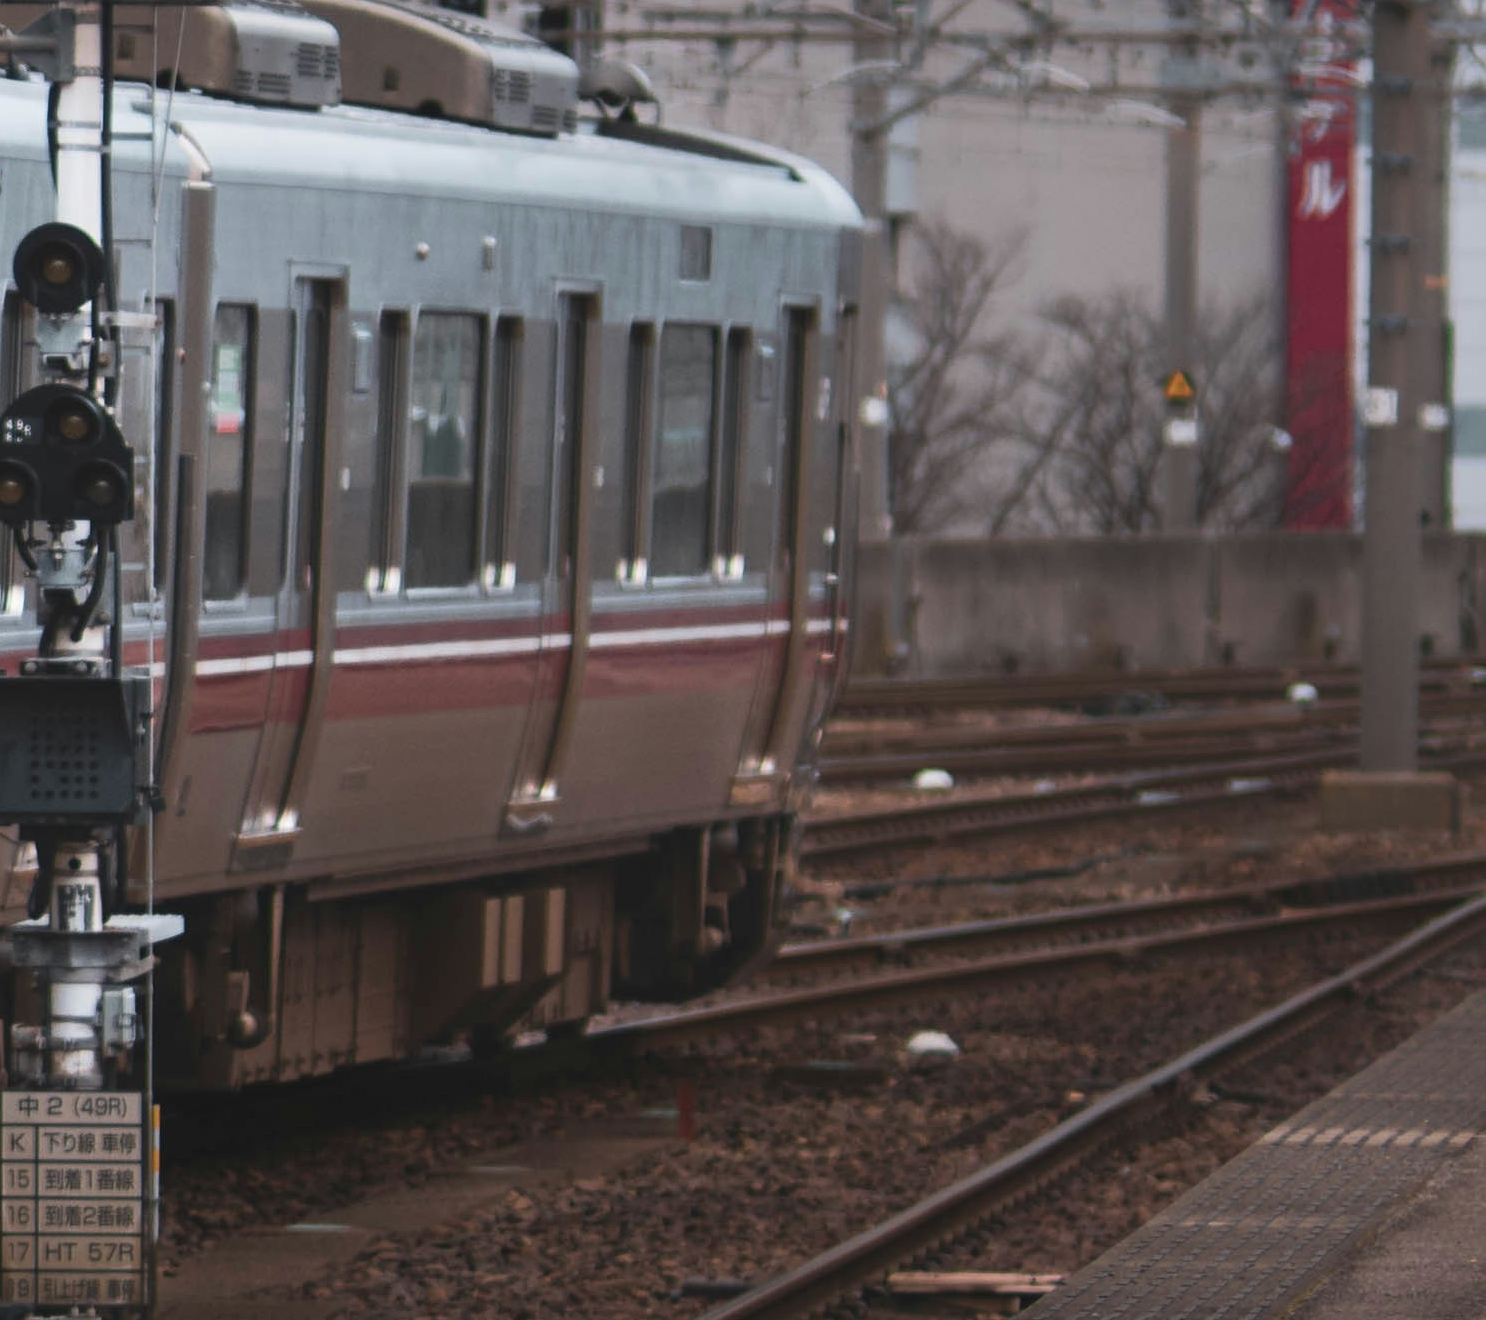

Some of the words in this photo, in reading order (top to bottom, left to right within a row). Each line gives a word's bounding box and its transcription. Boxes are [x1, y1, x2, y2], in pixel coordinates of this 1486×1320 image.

[18, 1095, 39, 1117] 中
[47, 1097, 63, 1115] 2
[74, 1096, 128, 1118] (49R)
[11, 1133, 25, 1152] K
[44, 1133, 96, 1154] 下り線
[9, 1169, 29, 1188] 15
[9, 1206, 29, 1225] 16
[9, 1243, 29, 1261] 17
[45, 1243, 77, 1261] HT
[88, 1243, 134, 1262] 57R
